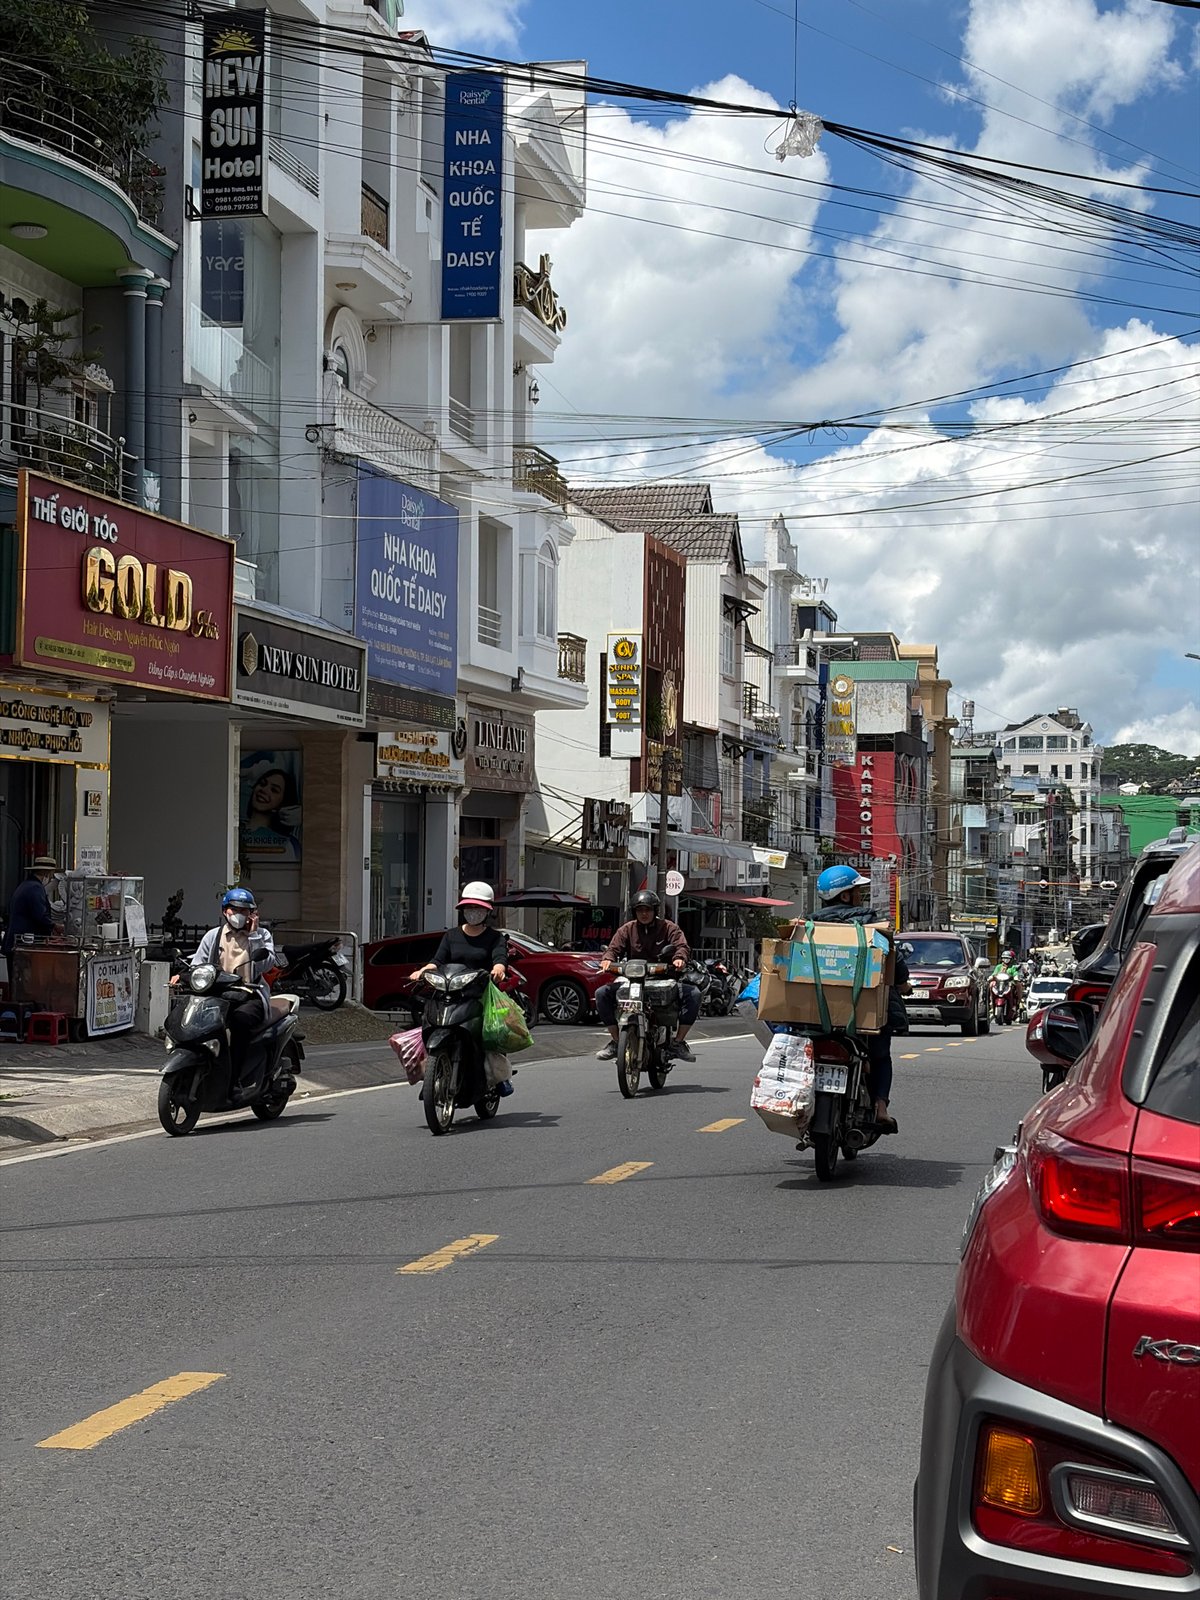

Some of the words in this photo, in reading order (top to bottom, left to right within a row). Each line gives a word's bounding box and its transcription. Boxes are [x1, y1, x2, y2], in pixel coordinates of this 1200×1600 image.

[206, 56, 262, 98] NEW
[460, 90, 481, 99] Daisy
[460, 96, 485, 105] Dental
[210, 106, 256, 148] SUN
[455, 129, 491, 146] NHA
[204, 155, 261, 179] Hotel
[449, 160, 496, 176] KHOA
[449, 184, 495, 207] QUỐC
[461, 215, 483, 237] TẾ
[446, 251, 495, 268] DAISY
[401, 494, 418, 514] Daisy
[33, 493, 60, 525] THẾ
[60, 505, 89, 535] GIỚI
[93, 514, 119, 544] TÓC
[384, 532, 407, 567] NHA
[409, 542, 437, 579] KHOA
[82, 546, 193, 632] GOLD
[371, 564, 401, 604] QUỐC
[403, 573, 418, 610] TẾ
[418, 586, 447, 619] DAISY
[83, 618, 97, 635] Hair
[149, 632, 164, 650] Phúc
[163, 664, 174, 681] Cấp
[178, 667, 197, 687] Chuyên
[262, 645, 293, 676] NEW
[295, 654, 320, 683] SUN
[321, 660, 360, 693] HOTEL
[609, 664, 639, 673] SUNNY
[616, 673, 633, 681] SPA
[609, 687, 638, 696] MASSAGE
[615, 698, 631, 706] BODY
[11, 700, 37, 720] CÔNG
[80, 712, 93, 727] VIP
[615, 712, 631, 720] FOOT
[831, 701, 852, 717] NAM
[397, 731, 438, 747] COSMETICS
[478, 720, 504, 750] LINH
[505, 726, 527, 754] ANH
[88, 792, 102, 807] 142
[860, 755, 873, 850] KARAOKE
[886, 853, 896, 867] 2
[776, 1054, 788, 1084] ACTION
[815, 1078, 841, 1091] 599
